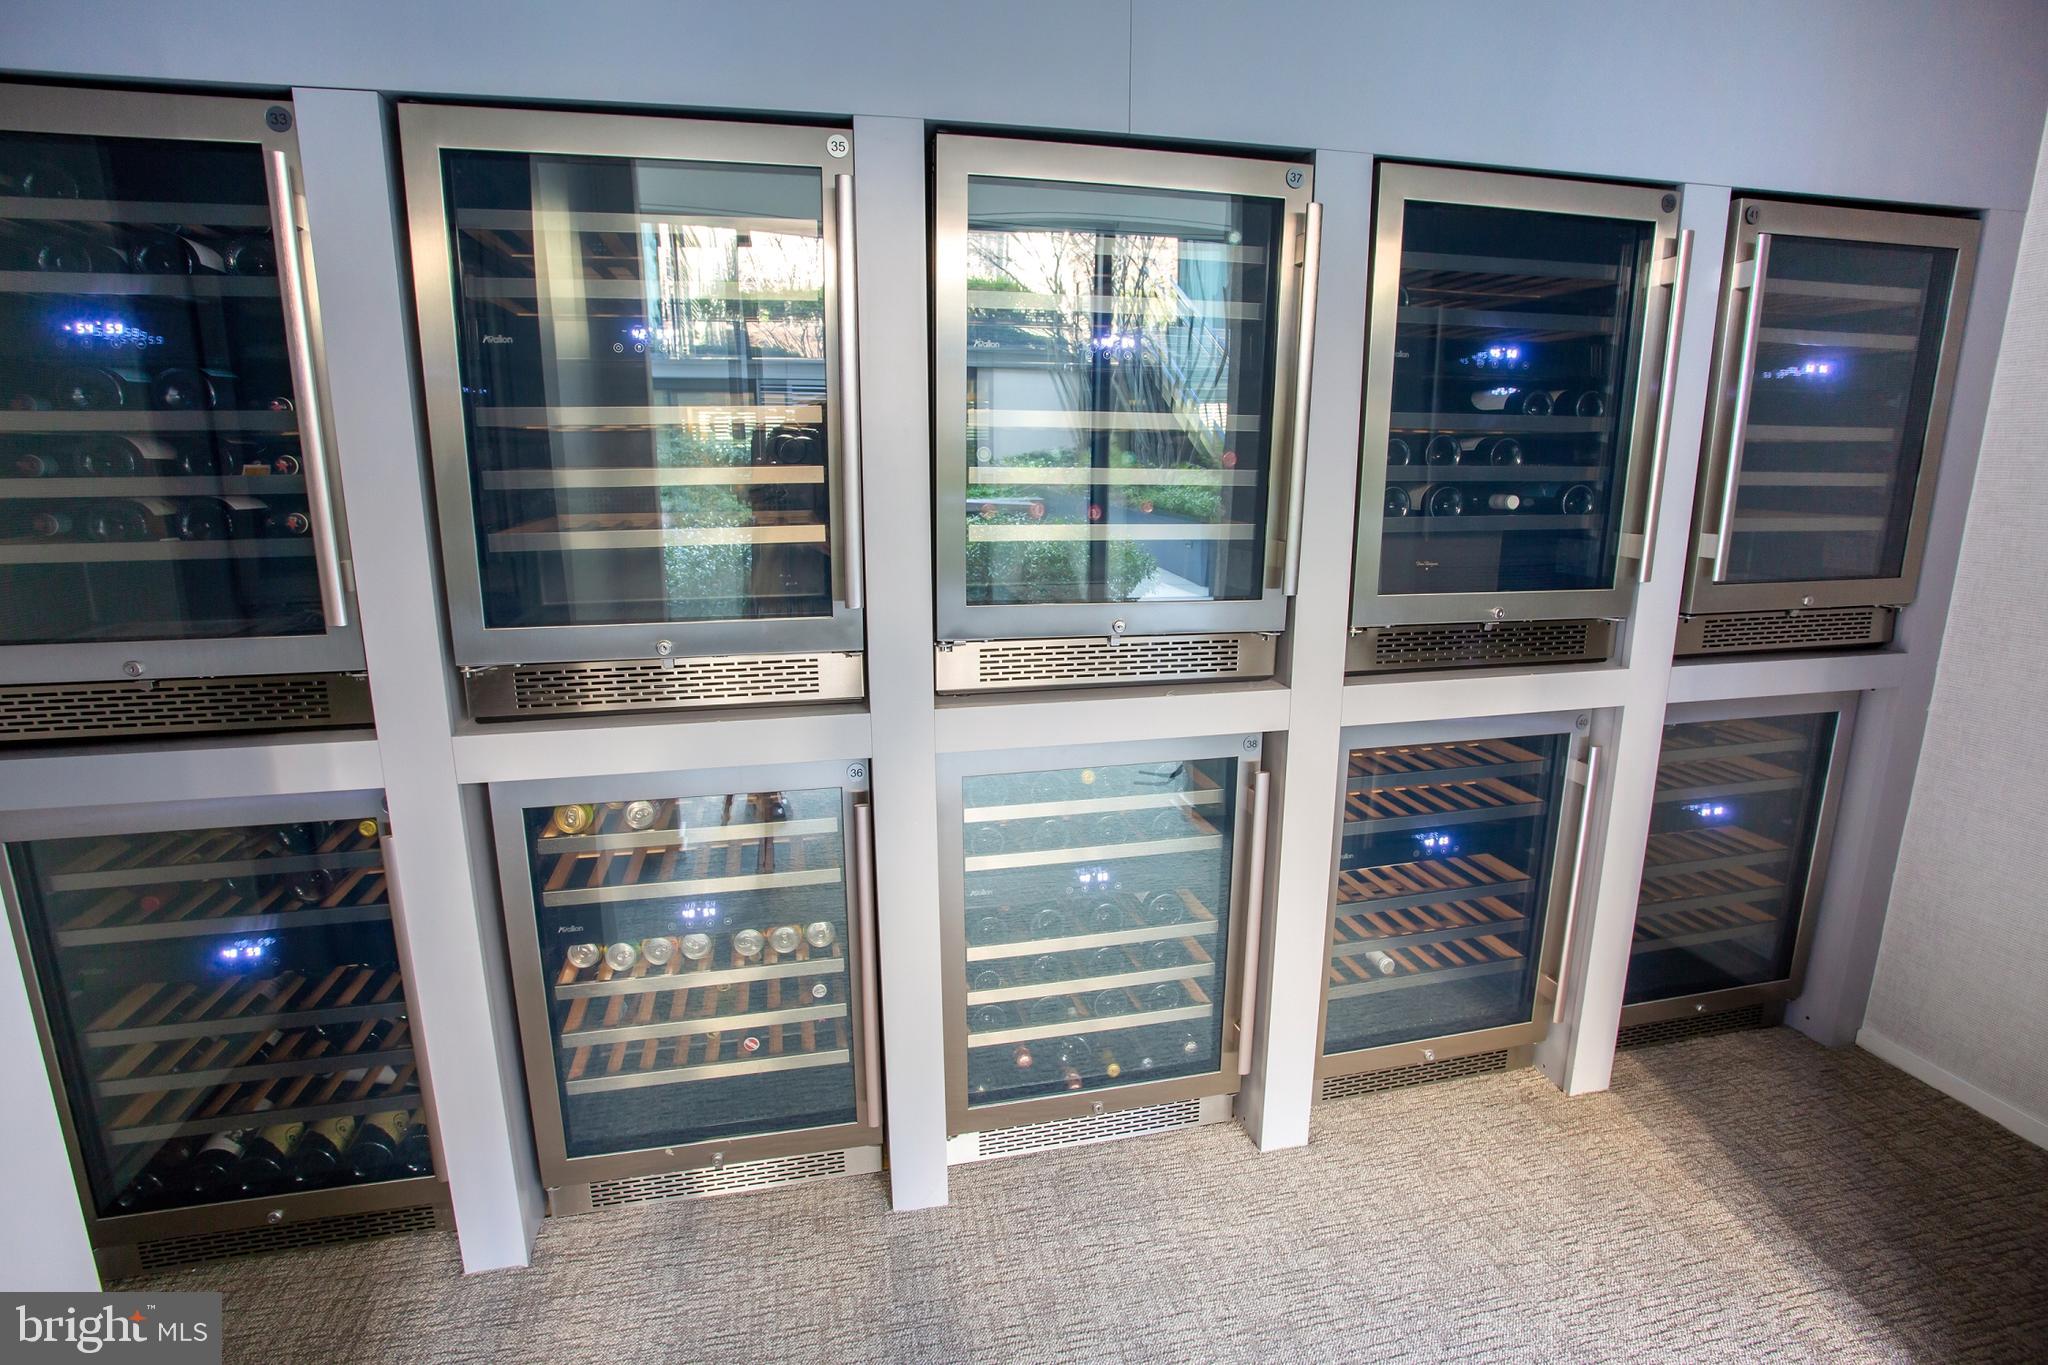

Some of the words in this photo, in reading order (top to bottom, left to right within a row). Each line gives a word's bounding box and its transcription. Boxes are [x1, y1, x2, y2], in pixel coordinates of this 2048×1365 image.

[269, 112, 288, 126] 33
[831, 140, 846, 153] 35
[1289, 172, 1303, 184] 37
[76, 322, 94, 334] 54
[1247, 739, 1257, 749] 38
[850, 768, 863, 778] 36
